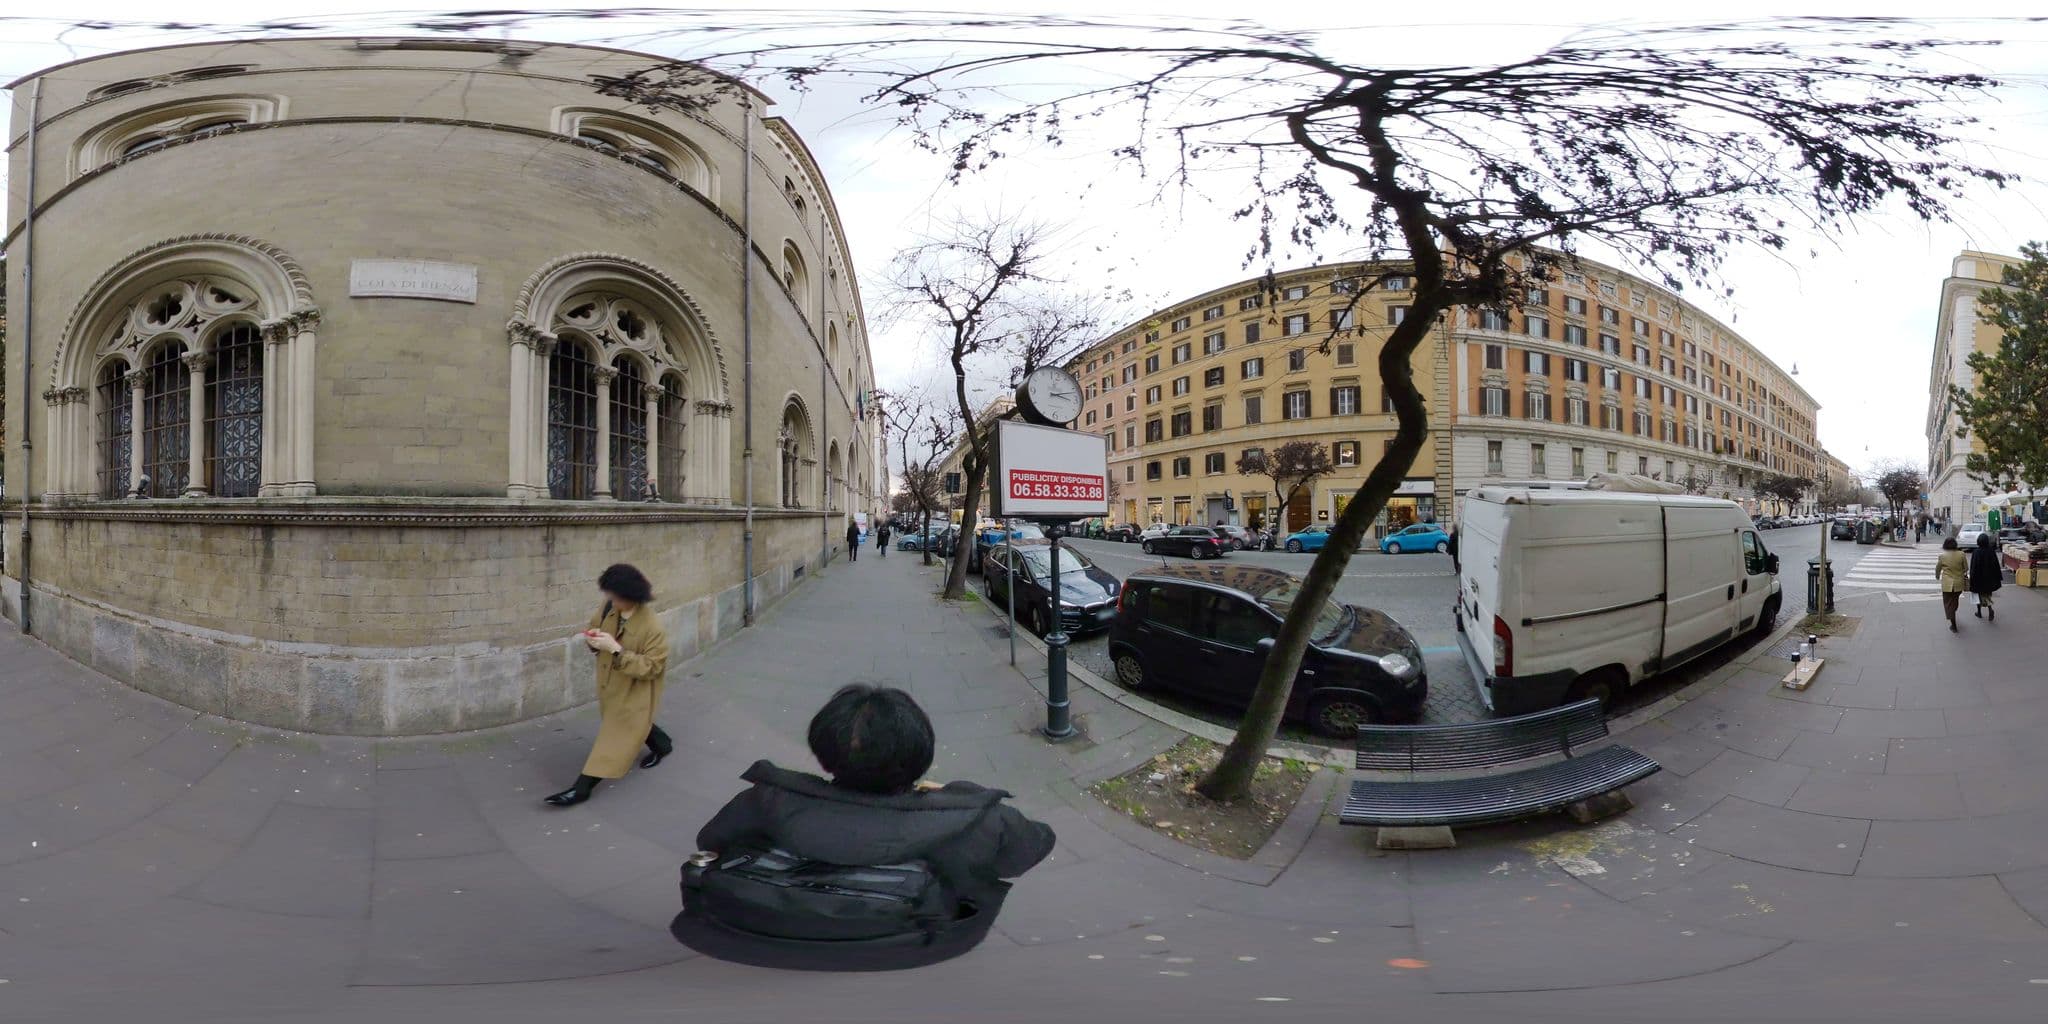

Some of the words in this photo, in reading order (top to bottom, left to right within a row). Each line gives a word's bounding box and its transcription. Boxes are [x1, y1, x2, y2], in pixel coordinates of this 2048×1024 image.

[401, 280, 415, 289] DI
[1012, 473, 1059, 483] PUBBLICITA'
[1060, 476, 1102, 486] DISPONIBILE
[1013, 483, 1102, 498] 06.58.33.33.88
